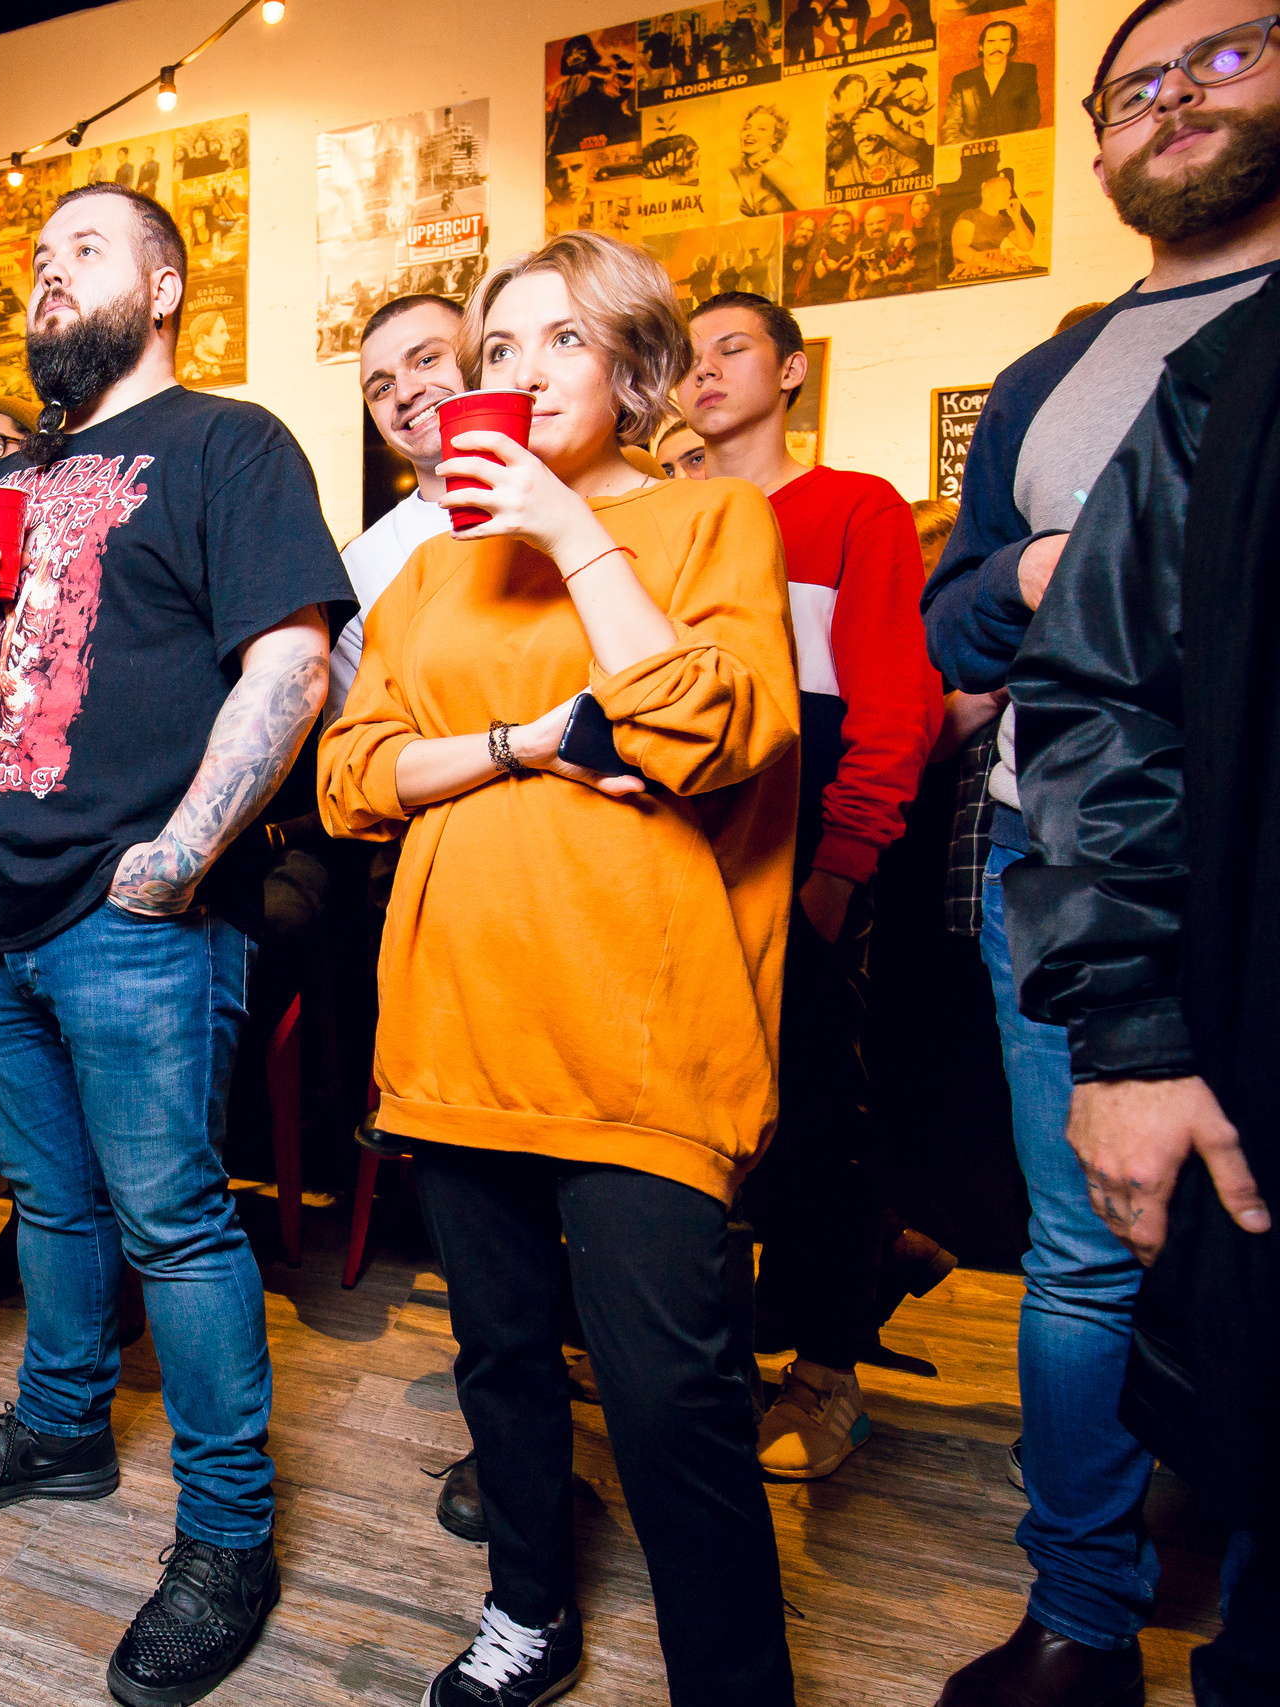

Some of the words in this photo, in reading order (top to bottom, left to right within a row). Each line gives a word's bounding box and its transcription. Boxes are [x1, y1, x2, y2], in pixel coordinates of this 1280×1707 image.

[783, 64, 805, 76] THE
[804, 56, 844, 73] VELVET
[847, 39, 934, 64] UNDERGROUND
[663, 74, 749, 100] RADIOHEAD
[825, 188, 843, 204] RED
[844, 186, 865, 201] HOT
[865, 186, 890, 197] CHILI
[891, 174, 933, 194] PEPPERS
[637, 200, 668, 217] MAD
[670, 194, 704, 213] MAX
[407, 215, 481, 246] UPPERCUT
[432, 236, 455, 246] DELUXE
[187, 295, 235, 312] BUDAPEST
[196, 286, 226, 298] GRAND
